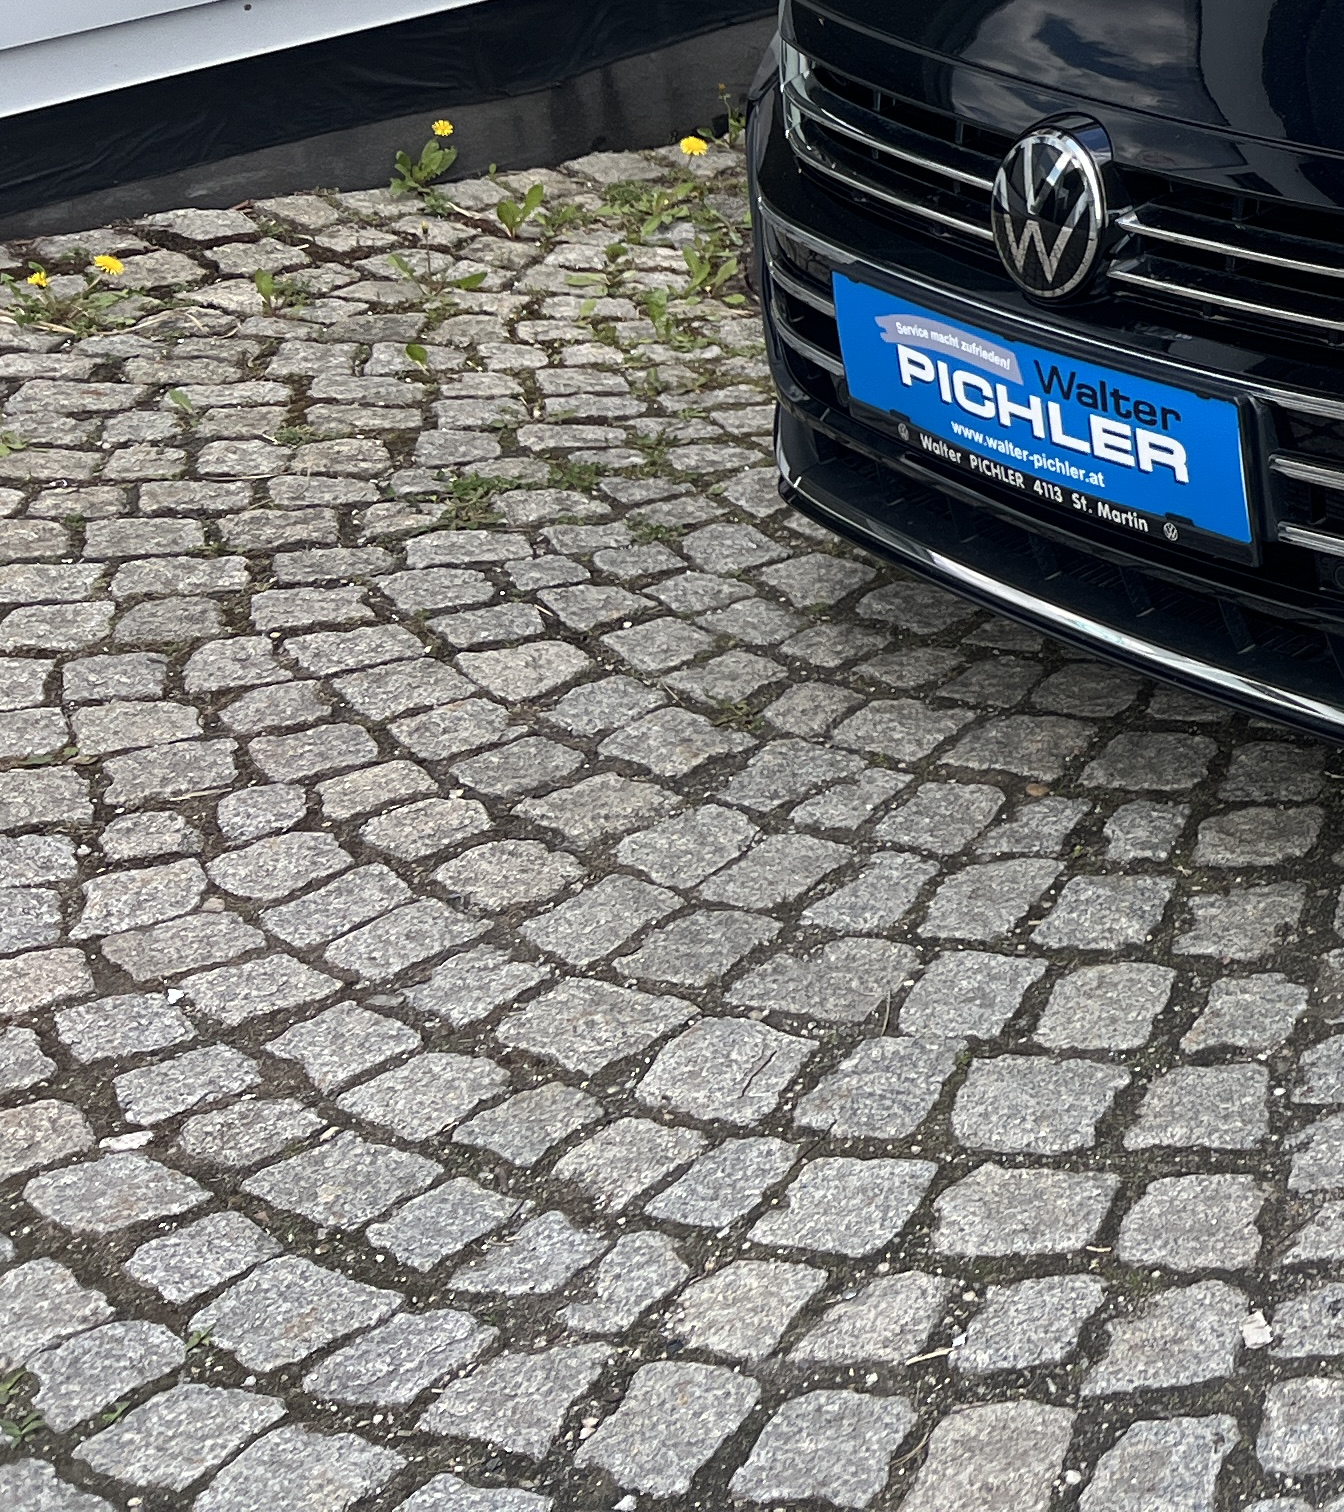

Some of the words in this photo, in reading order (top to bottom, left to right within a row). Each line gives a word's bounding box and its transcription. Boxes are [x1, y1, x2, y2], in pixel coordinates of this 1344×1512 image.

[895, 322, 929, 339] Service
[930, 330, 960, 349] macht
[960, 339, 1011, 371] zufrieden!
[896, 343, 1191, 485] PICHLER
[1033, 359, 1182, 432] Walter
[919, 432, 962, 465] Walter
[969, 454, 1026, 489] PICHLER
[1033, 481, 1064, 504] 4113
[1071, 493, 1093, 514] St.
[1097, 501, 1149, 533] Martin
[951, 420, 1106, 488] www.walter-pichler.at
